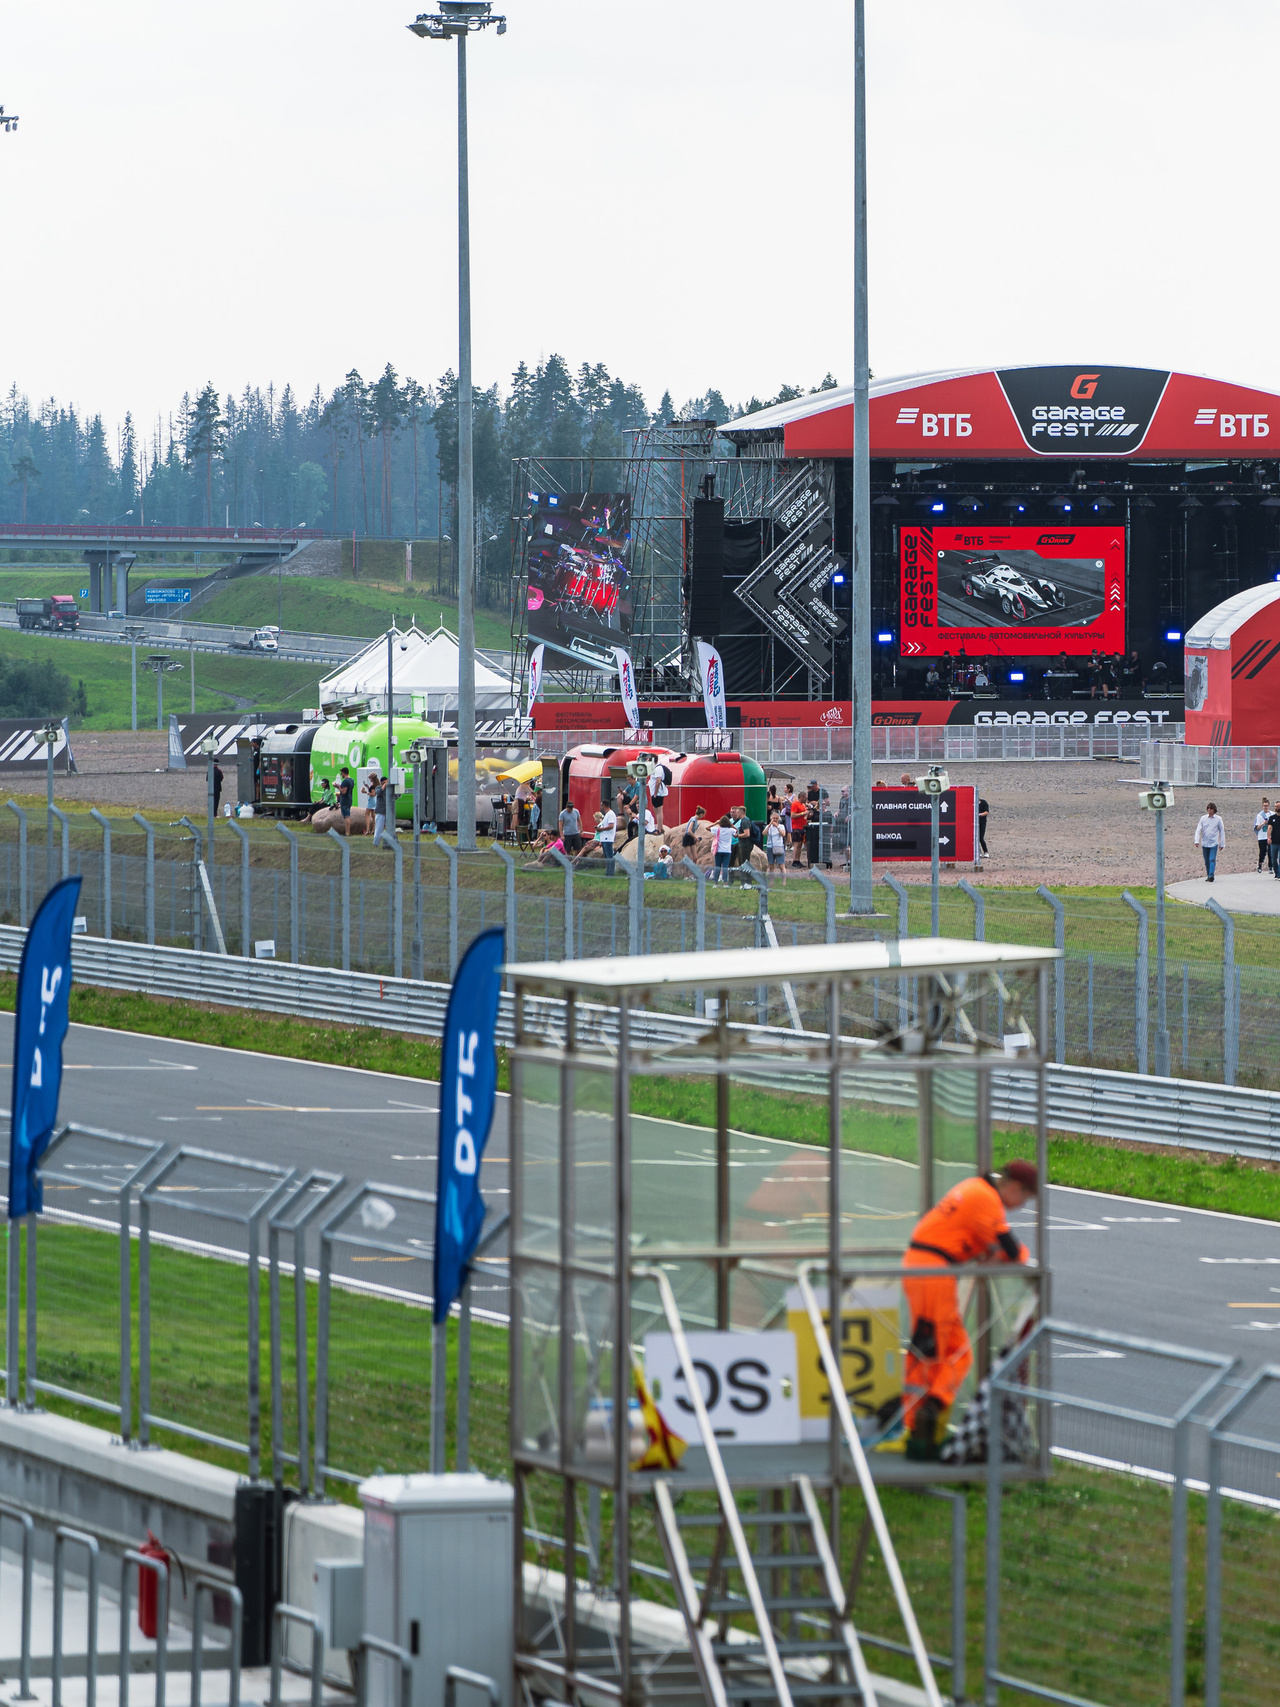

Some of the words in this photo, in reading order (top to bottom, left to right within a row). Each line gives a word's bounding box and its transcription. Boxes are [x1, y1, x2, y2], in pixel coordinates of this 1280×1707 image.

[1031, 406, 1126, 420] GARAGE
[922, 413, 973, 437] ВТБ
[1031, 423, 1095, 437] FEST
[1220, 413, 1270, 437] ВТБ
[964, 536, 984, 546] ВТБ
[904, 534, 918, 628] GARAGE
[920, 566, 933, 628] FEST
[937, 632, 987, 640] ФЕСТИВАЛЬ
[989, 631, 1062, 640] АВТОМОБИЛЬНОЙ
[1064, 632, 1106, 640] КУЛЬТУРЫ
[750, 718, 771, 728] ВТБ
[974, 711, 1088, 726] GARAGE
[1094, 711, 1170, 726] FEST
[908, 803, 932, 811] СЦЕНА
